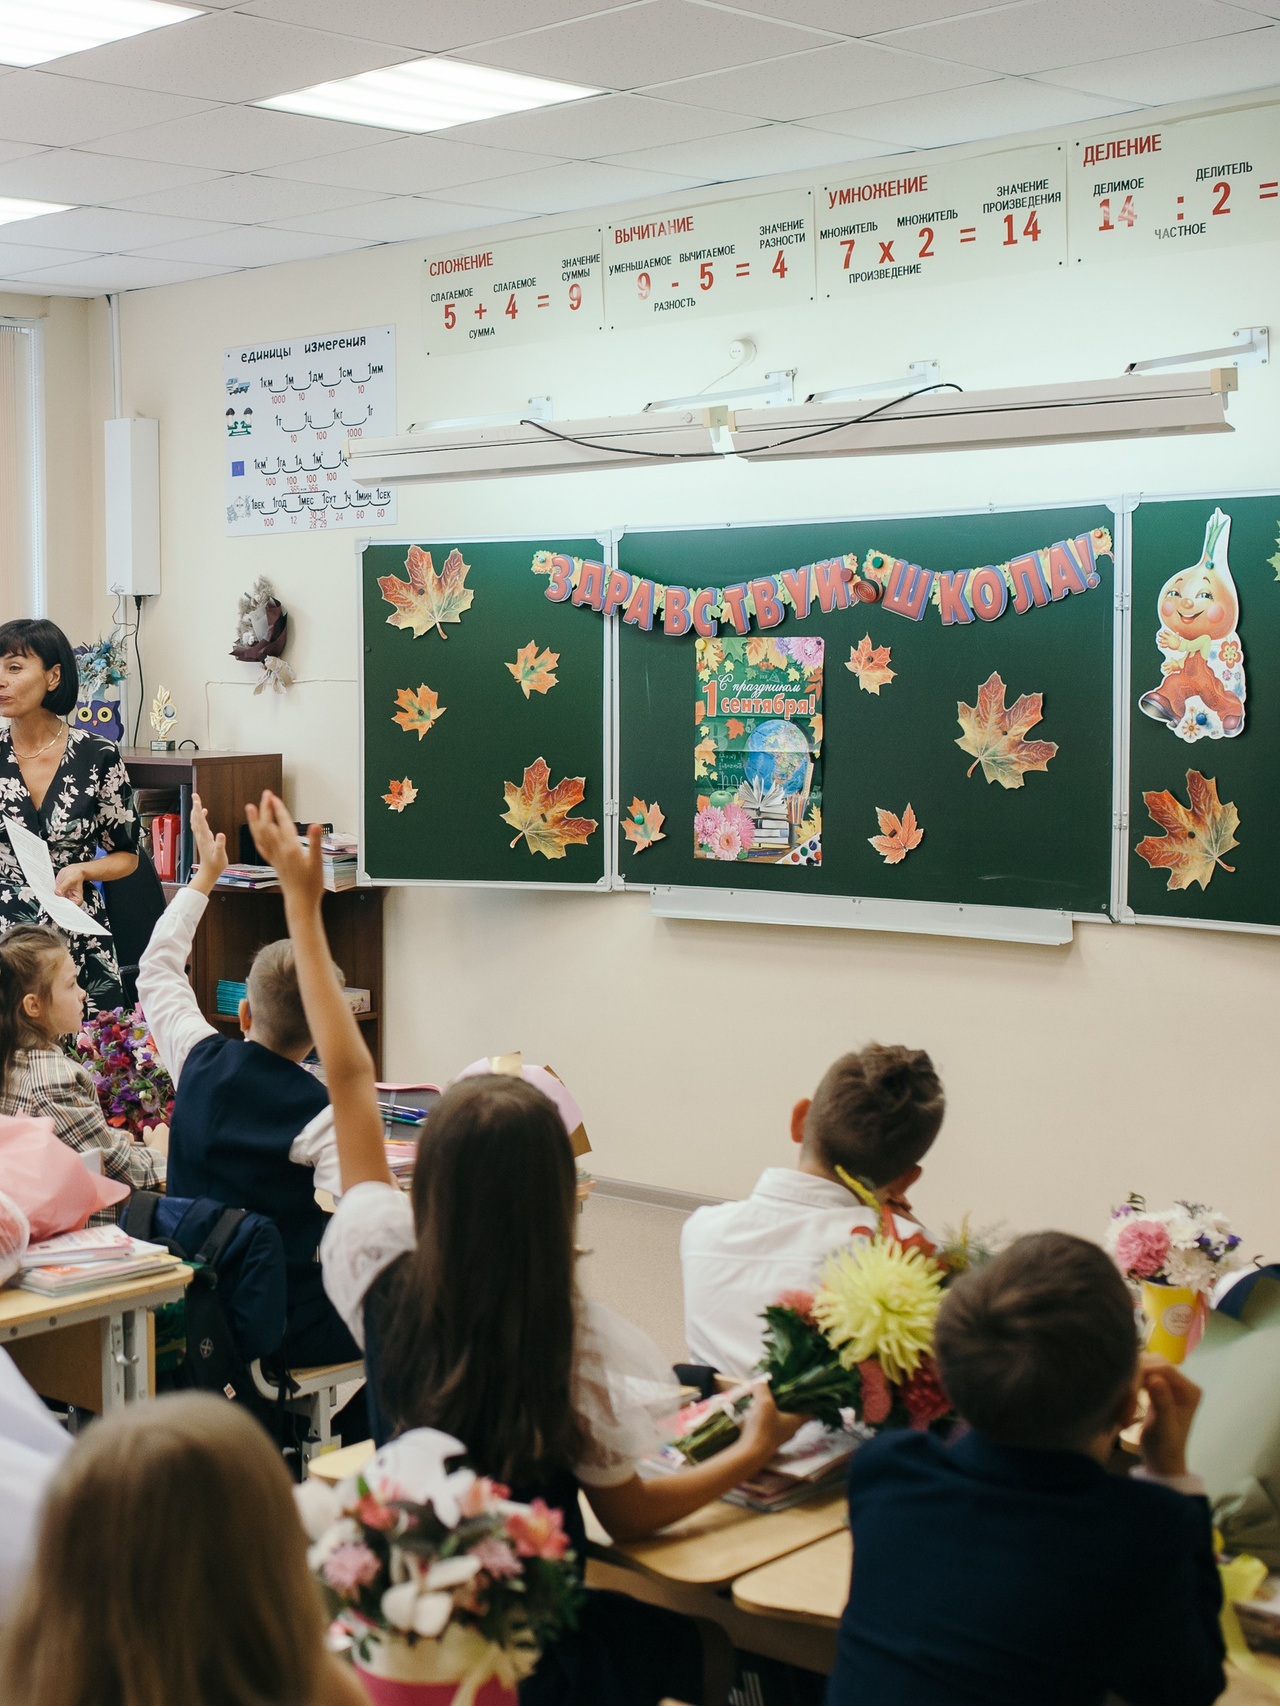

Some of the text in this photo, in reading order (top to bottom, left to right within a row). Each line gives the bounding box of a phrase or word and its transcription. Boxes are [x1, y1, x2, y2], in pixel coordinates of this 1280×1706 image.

[1083, 134, 1162, 167] ДЕЛЕНИЕ
[1196, 162, 1253, 182] ДЕЛИТЕЛЬ
[829, 175, 927, 209] УМНОЖЕНИЕ
[996, 179, 1049, 196] ЗНАЧЕНИЕ
[1093, 178, 1144, 197] ДЕЛИМОЕ
[983, 192, 1061, 214] ПРОИЗВЕДЕНИЯ
[1098, 195, 1137, 231] 14
[1212, 182, 1231, 215] 2
[615, 216, 694, 244] ВЫЧИТАНИЕ
[759, 219, 804, 236] ЗНАЧЕНИЕ
[820, 209, 958, 240] МНОЖИТЕЛЬ МНОЖИТЕЛЬ
[1155, 223, 1206, 240] ЧАСТНОЕ
[760, 233, 805, 249] РАЗНОСТИ
[840, 239, 855, 269] 7
[918, 227, 934, 258] 2
[1003, 211, 1041, 246] 14
[429, 252, 493, 276] СЛОЖЕНИЕ
[561, 253, 600, 268] ЗНАЧЕНИЕ
[609, 245, 735, 275] УМЕНЬШАЕМОЕ ВЫЧИТАЕМОЕ
[561, 268, 590, 281] СУММЫ
[637, 272, 651, 300] 9
[700, 262, 714, 290] 5
[772, 250, 787, 279] 4
[849, 263, 921, 284] ПРОИЗВЕДЕНИЕ
[431, 277, 536, 302] СЛАГАЕМОЕ СЛАГАЕМОЕ
[444, 304, 456, 329] 5
[505, 294, 518, 319] 4
[569, 283, 581, 310] 9
[654, 298, 695, 311] РАЗНОСТЬ
[469, 327, 495, 339] СУММА
[241, 336, 366, 363] единицы измерения
[881, 531, 1100, 627] ШКОЛА!
[703, 680, 815, 720] 1 сентября!
[732, 680, 801, 698] праздником
